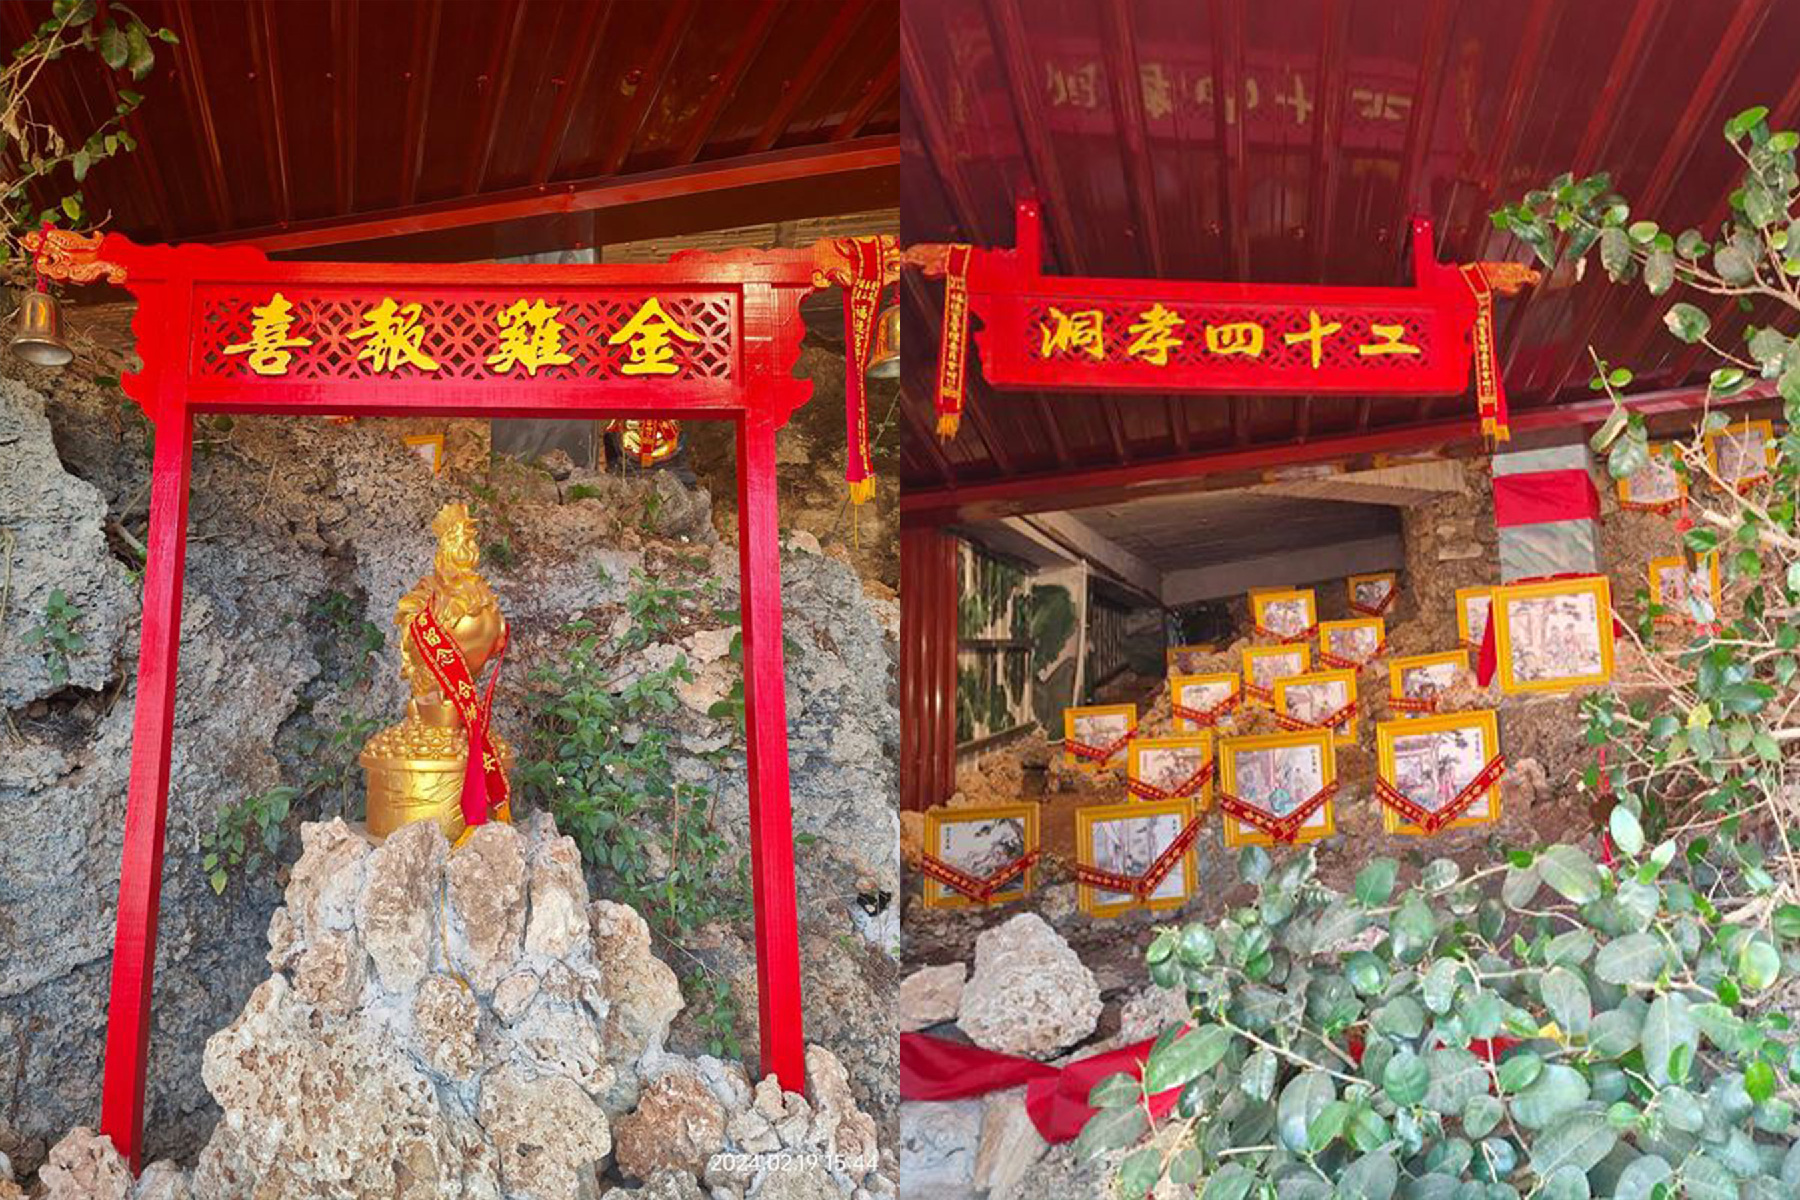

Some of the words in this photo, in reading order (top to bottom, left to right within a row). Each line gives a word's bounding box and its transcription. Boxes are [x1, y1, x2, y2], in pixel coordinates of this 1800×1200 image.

[224, 292, 703, 376] 金雞報喜
[1040, 303, 1420, 369] 二十四孝洞
